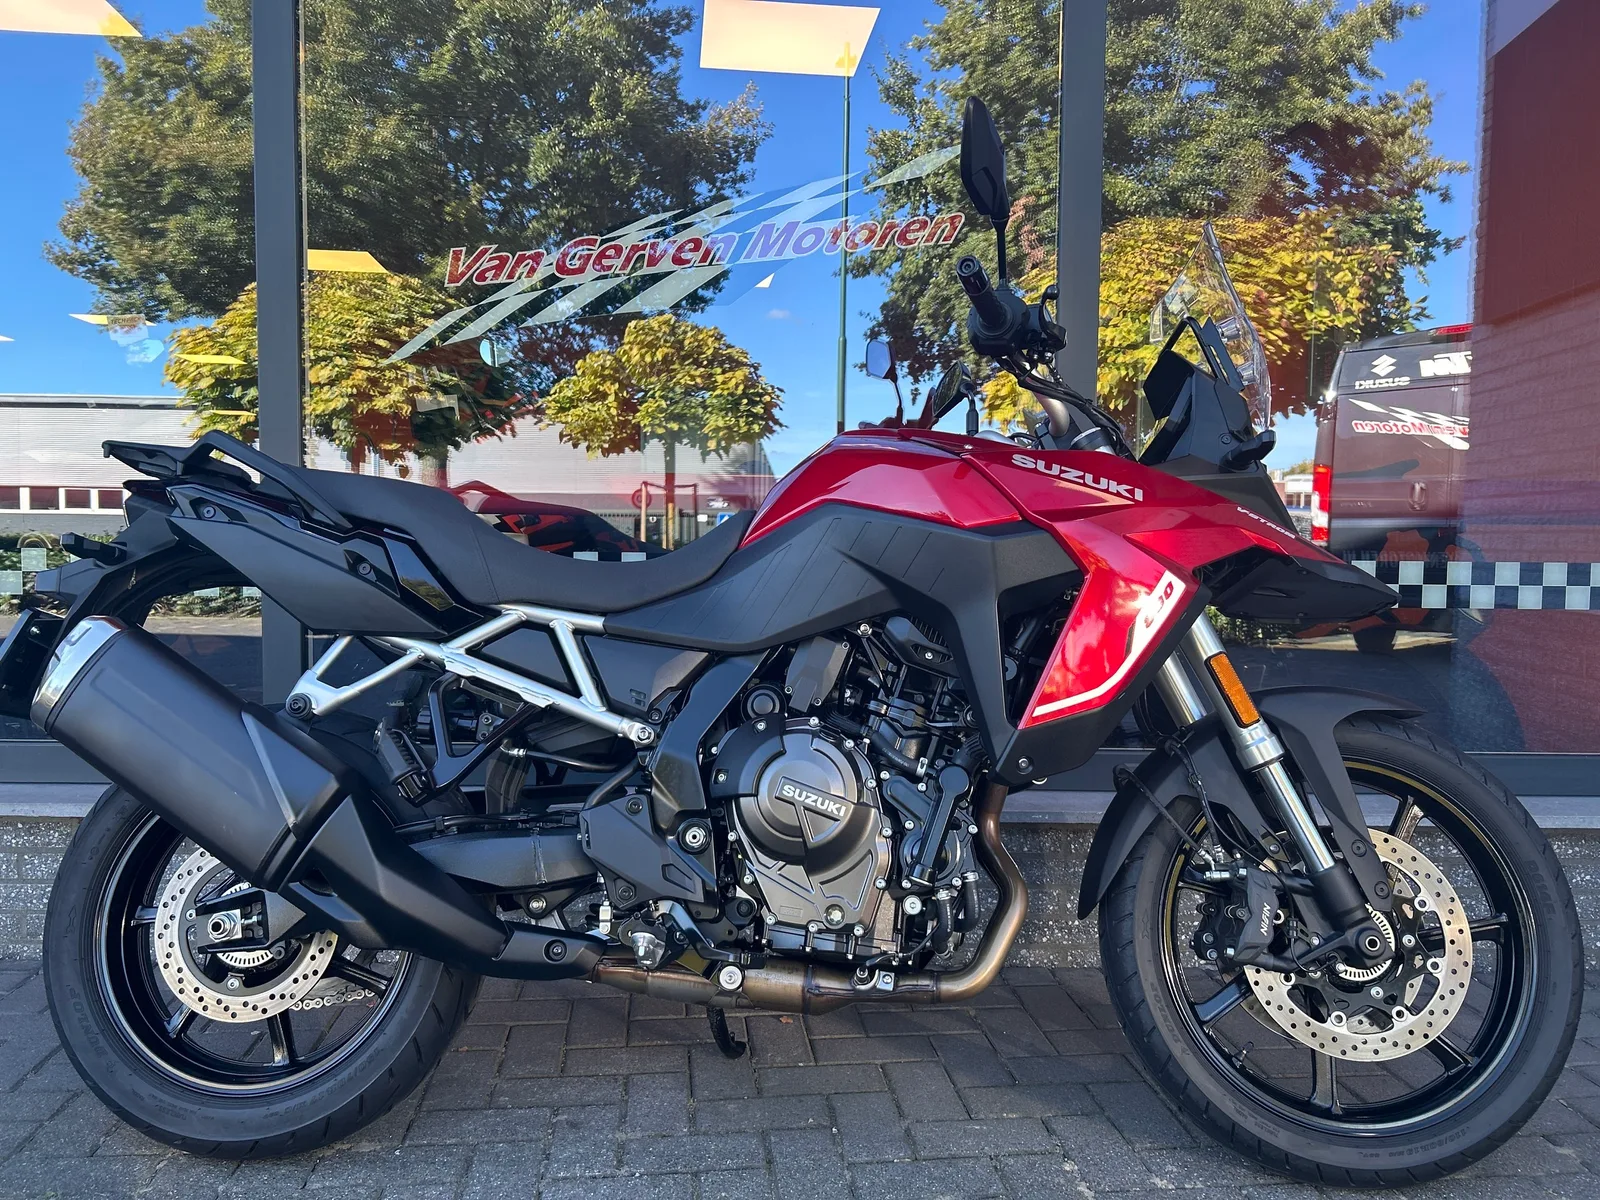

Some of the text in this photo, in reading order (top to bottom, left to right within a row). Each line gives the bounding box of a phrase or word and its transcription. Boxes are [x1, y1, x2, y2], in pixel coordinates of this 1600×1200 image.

[444, 211, 966, 287] Van Gerven Motoren
[1011, 453, 1143, 502] SUZUKI
[782, 784, 847, 817] SUZUKI
[68, 987, 109, 1059] DUNLOP
